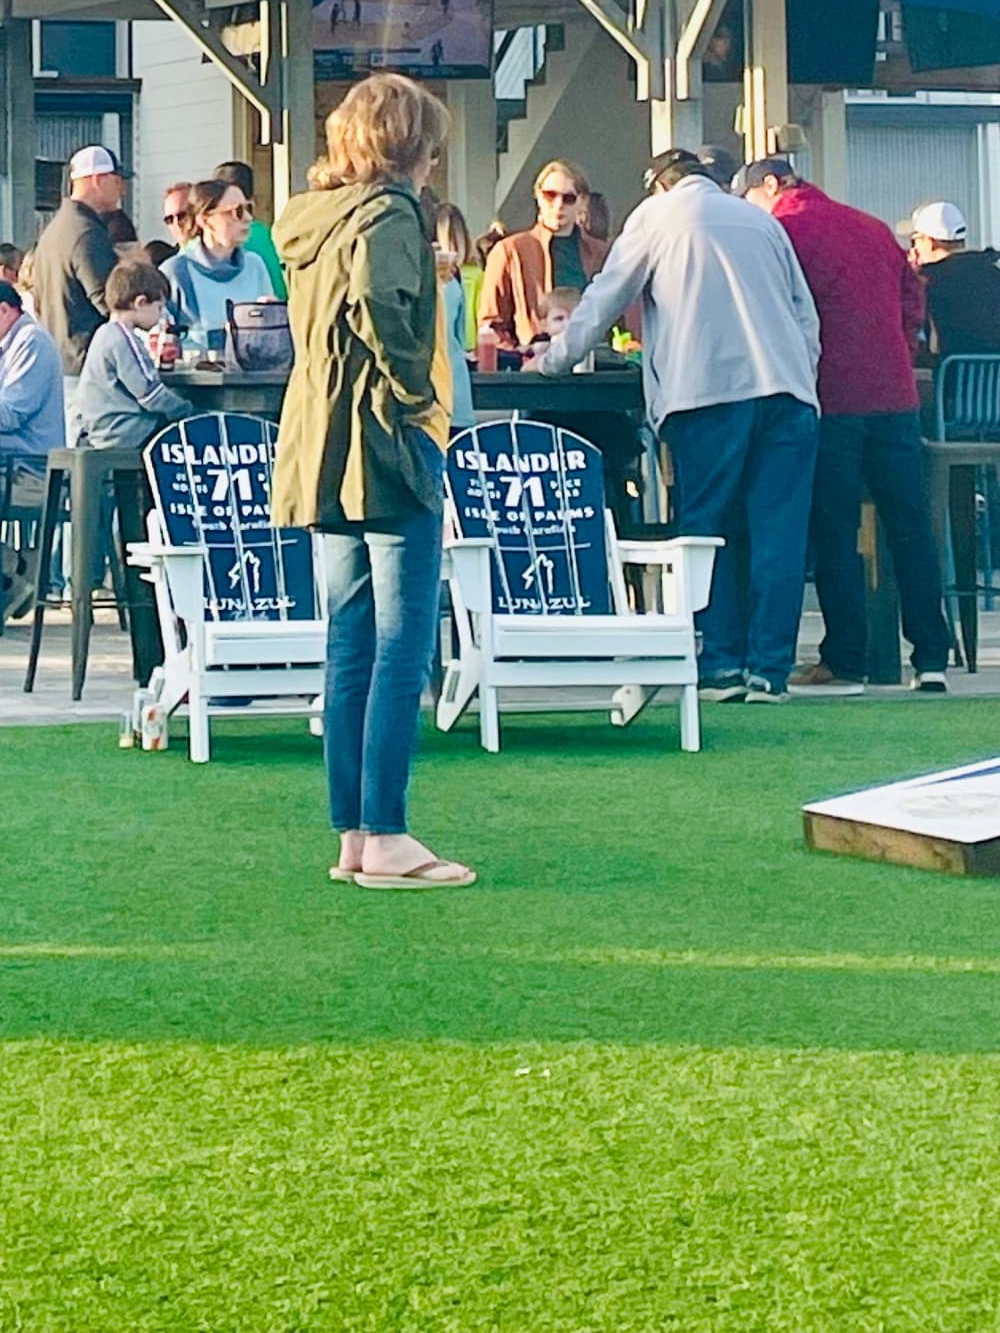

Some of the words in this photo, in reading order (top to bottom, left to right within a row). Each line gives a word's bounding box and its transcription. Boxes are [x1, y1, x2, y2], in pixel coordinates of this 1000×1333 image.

[161, 443, 278, 465] ISLANDE
[455, 449, 587, 473] ISLANDER
[206, 468, 253, 501] 71
[499, 476, 546, 507] 71
[170, 502, 208, 517] ISLE
[241, 504, 271, 516] PAL
[464, 507, 501, 522] ISLE
[534, 506, 595, 522] PALMS
